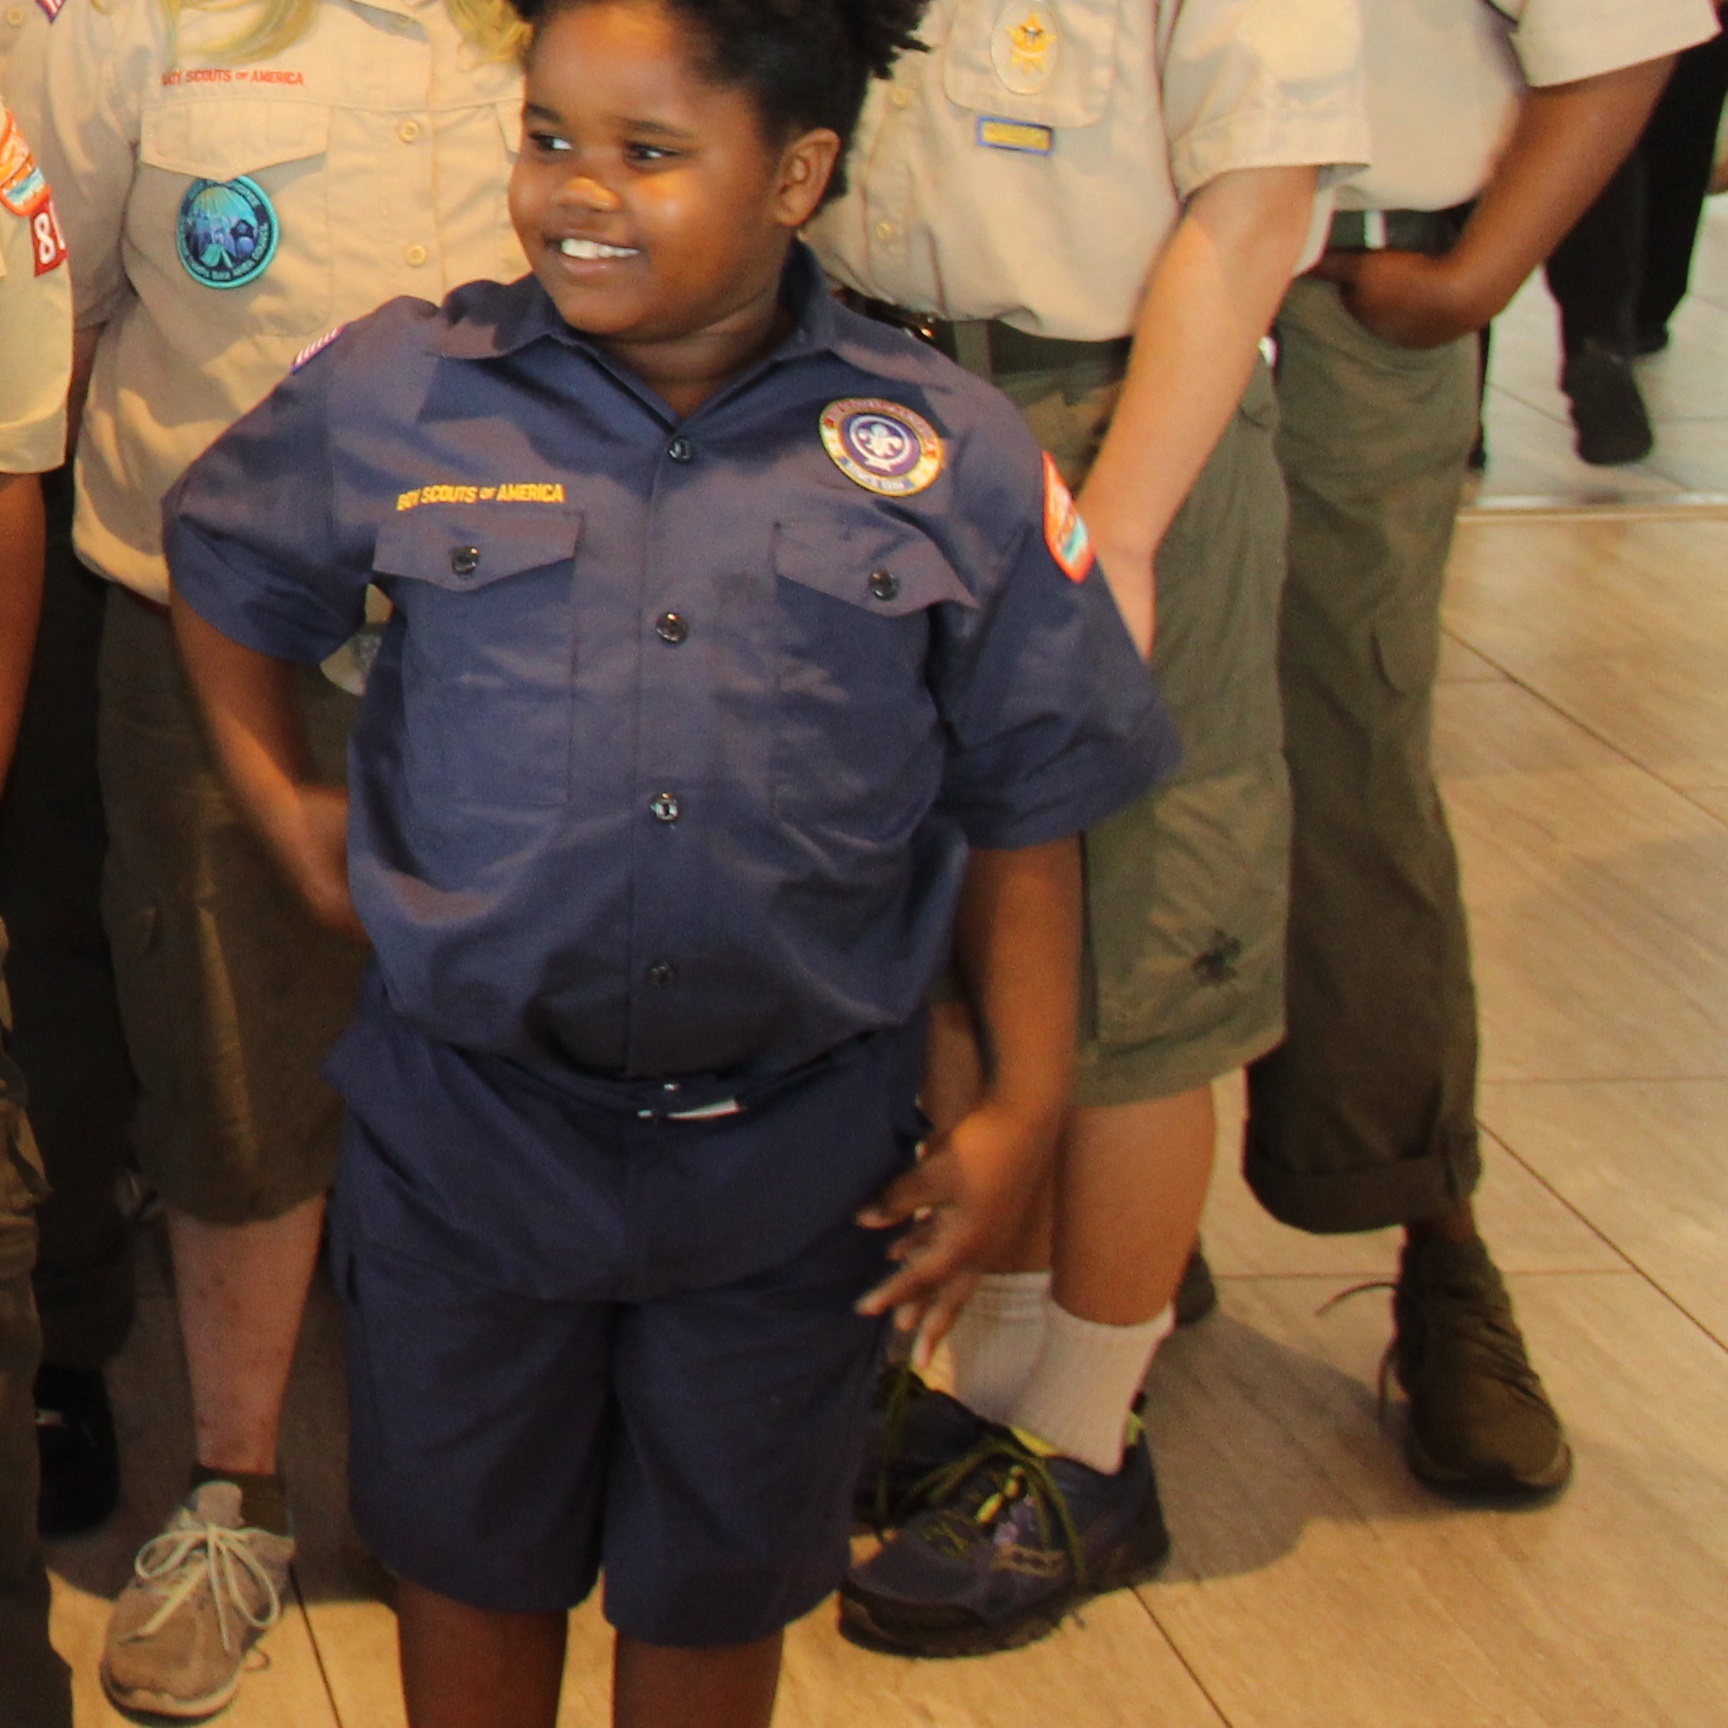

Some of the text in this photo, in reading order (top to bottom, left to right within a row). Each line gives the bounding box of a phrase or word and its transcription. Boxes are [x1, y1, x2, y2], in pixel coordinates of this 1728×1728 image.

[420, 483, 478, 504] SCOUTS
[479, 486, 496, 500] OF
[496, 483, 566, 504] AMERICA
